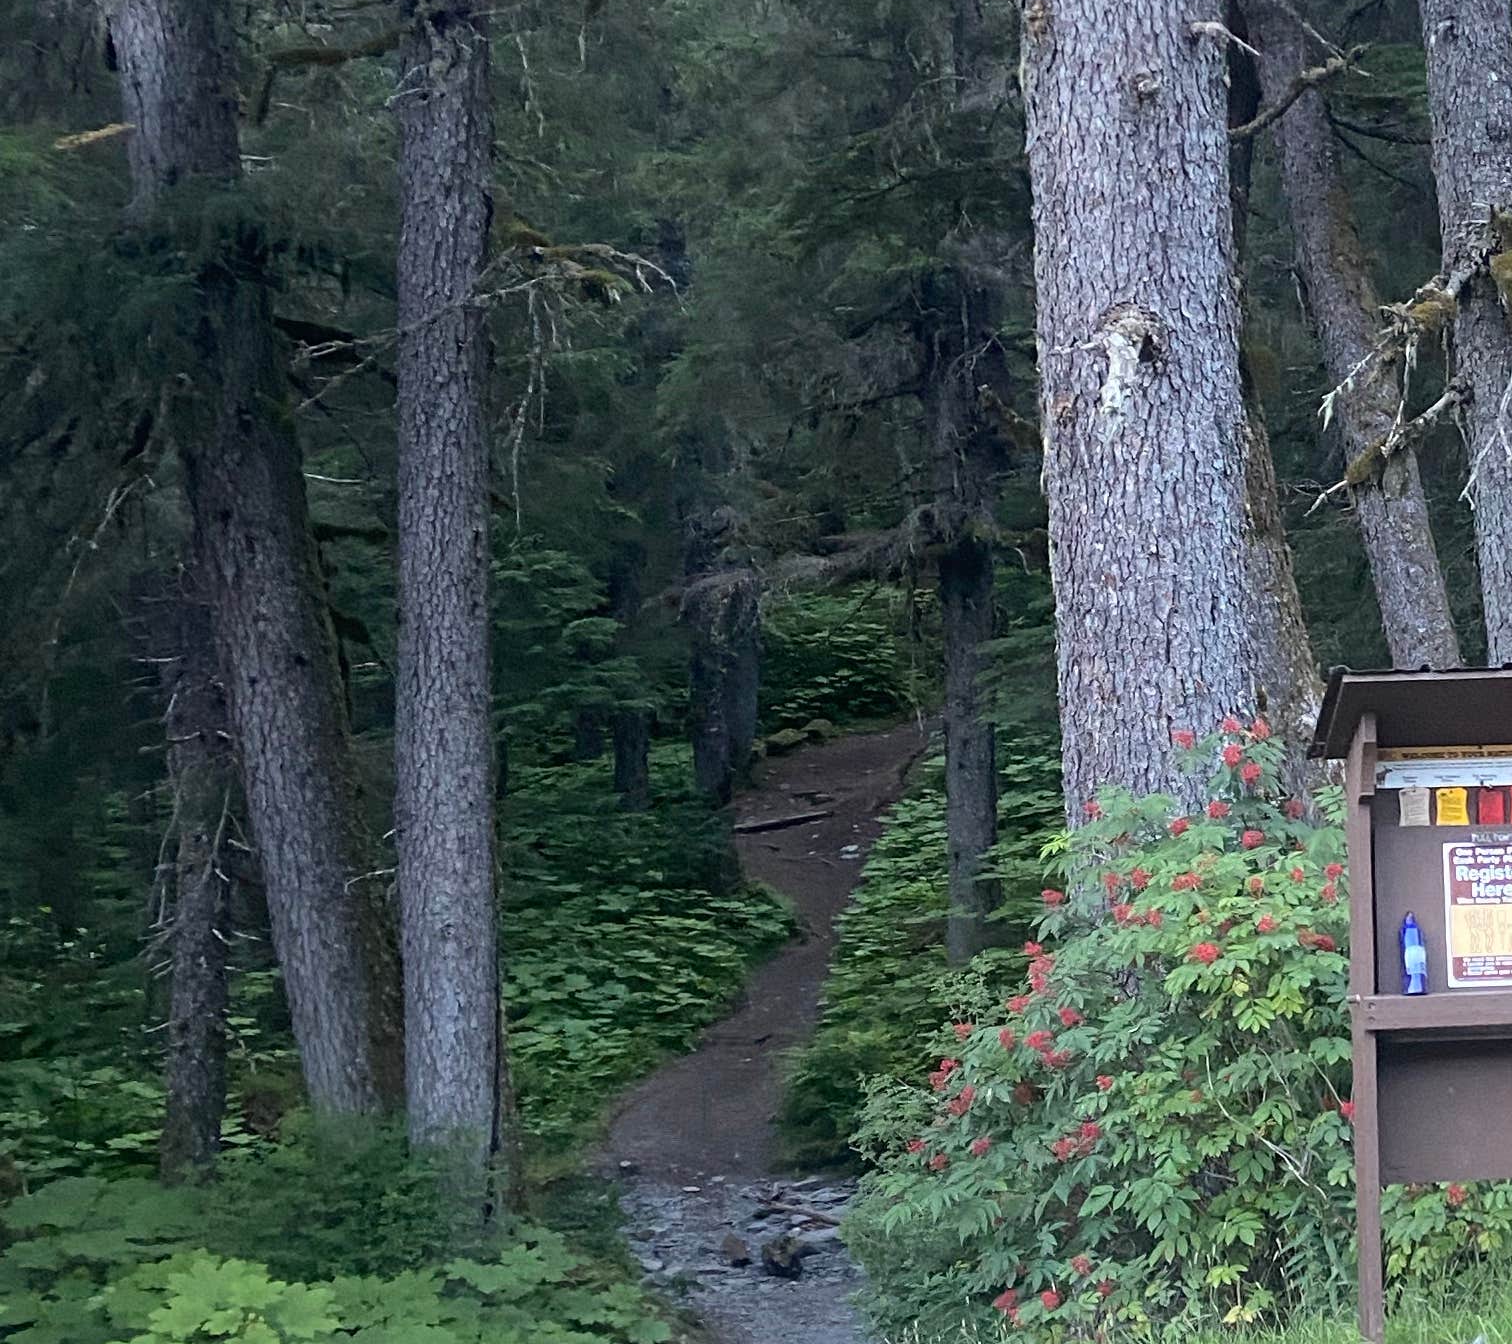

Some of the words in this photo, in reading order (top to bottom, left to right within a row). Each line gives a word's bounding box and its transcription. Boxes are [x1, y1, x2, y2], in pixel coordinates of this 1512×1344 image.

[1455, 848, 1473, 856] One
[1475, 846, 1505, 855] Person
[1477, 856, 1500, 865] Party
